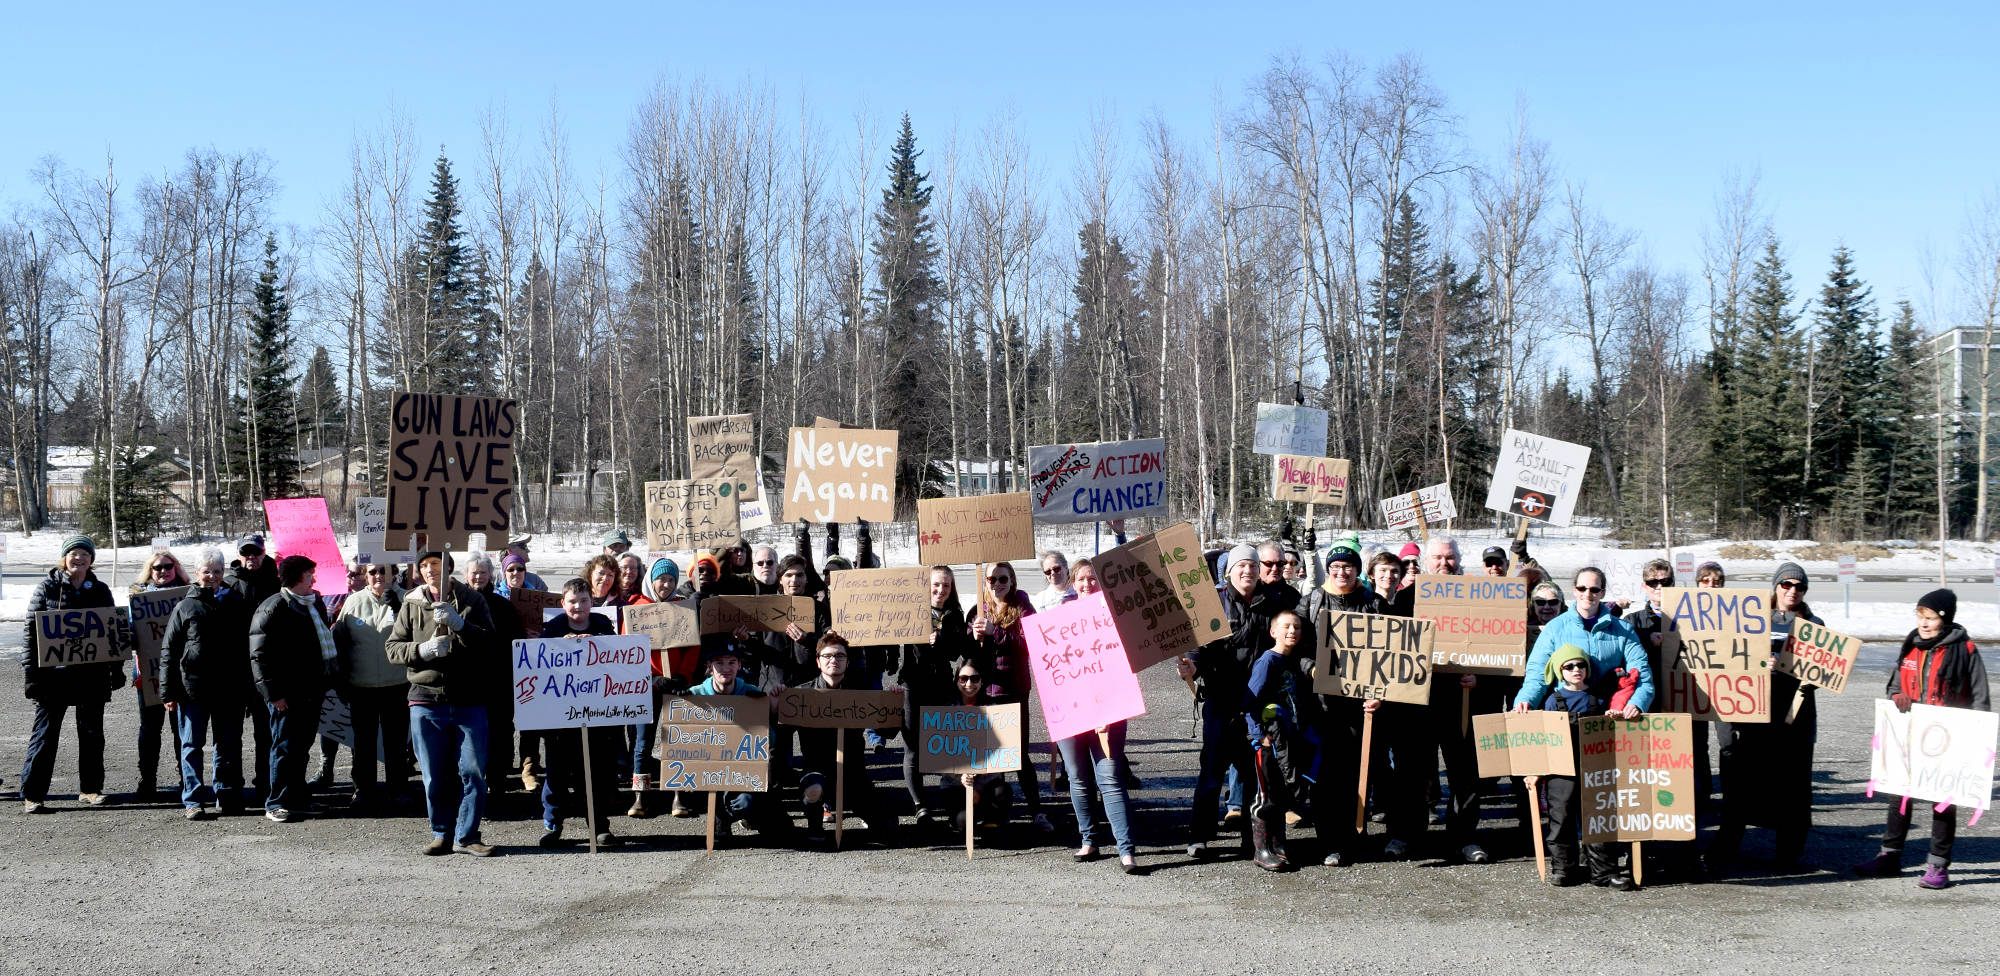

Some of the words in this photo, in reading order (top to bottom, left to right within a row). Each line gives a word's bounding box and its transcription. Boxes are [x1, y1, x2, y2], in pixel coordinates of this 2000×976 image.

[393, 393, 442, 435] GUN
[452, 397, 517, 439] LAWS
[689, 417, 753, 438] UNIVERSAL
[793, 429, 894, 470] Never
[1513, 437, 1543, 454] BAN
[393, 438, 511, 485] SAVE
[1515, 451, 1577, 478] ASSAULT
[649, 484, 717, 503] REGISTER
[791, 470, 889, 522] Again
[1072, 480, 1164, 515] CHANGE!
[388, 485, 512, 531] LIVES
[936, 509, 969, 525] NOT
[650, 518, 695, 533] MAKE
[699, 515, 714, 526] A
[659, 529, 735, 546] DIFFERENCE
[834, 573, 870, 591] Please
[872, 576, 910, 588] excuse
[1102, 561, 1151, 589] Give
[1177, 557, 1210, 590] not
[1420, 582, 1464, 598] SAFE
[1470, 582, 1526, 599] HOMES
[836, 602, 851, 624] We
[855, 613, 872, 622] are
[878, 606, 911, 627] trying
[917, 604, 930, 620] to
[1670, 592, 1766, 634] ARMS
[42, 611, 105, 639] USA
[632, 622, 668, 632] Educate
[875, 624, 890, 639] the
[1461, 617, 1527, 635] SCHOOLS
[1090, 638, 1120, 655] from
[1798, 622, 1848, 655] GUN
[45, 643, 96, 662] NRA
[1450, 652, 1525, 666] COMMUNITY
[1672, 638, 1725, 670] ARE
[1731, 638, 1750, 670] 4
[1785, 635, 1848, 675] REFORM
[1329, 649, 1360, 680] MY
[1370, 650, 1426, 686] KIDS
[1792, 658, 1843, 691] NOW!!
[516, 676, 538, 704] IS
[543, 674, 560, 697] A
[1341, 683, 1387, 700] SAFE!
[1670, 672, 1766, 715] HUGS!!
[583, 706, 605, 720] Martin
[669, 699, 735, 721] Firearm
[923, 711, 989, 731] MARCH
[990, 710, 1019, 728] FOR
[668, 725, 727, 745] Deaths
[721, 748, 733, 760] in
[735, 733, 768, 760] AK
[927, 734, 970, 757] OUR
[1479, 732, 1564, 750] #NEVERAGAIN
[1583, 735, 1633, 756] watch
[1640, 735, 1673, 752] like
[1881, 705, 1951, 788] NO
[970, 748, 1020, 769] LIVES
[1627, 755, 1641, 766] a
[1647, 752, 1694, 769] HAWK
[665, 761, 697, 789] 2x
[1584, 768, 1621, 788] KEEP
[1628, 768, 1671, 786] KIDS
[1595, 788, 1640, 811] SAFE
[1588, 812, 1651, 835] AROUND
[1652, 812, 1696, 833] GUNS
